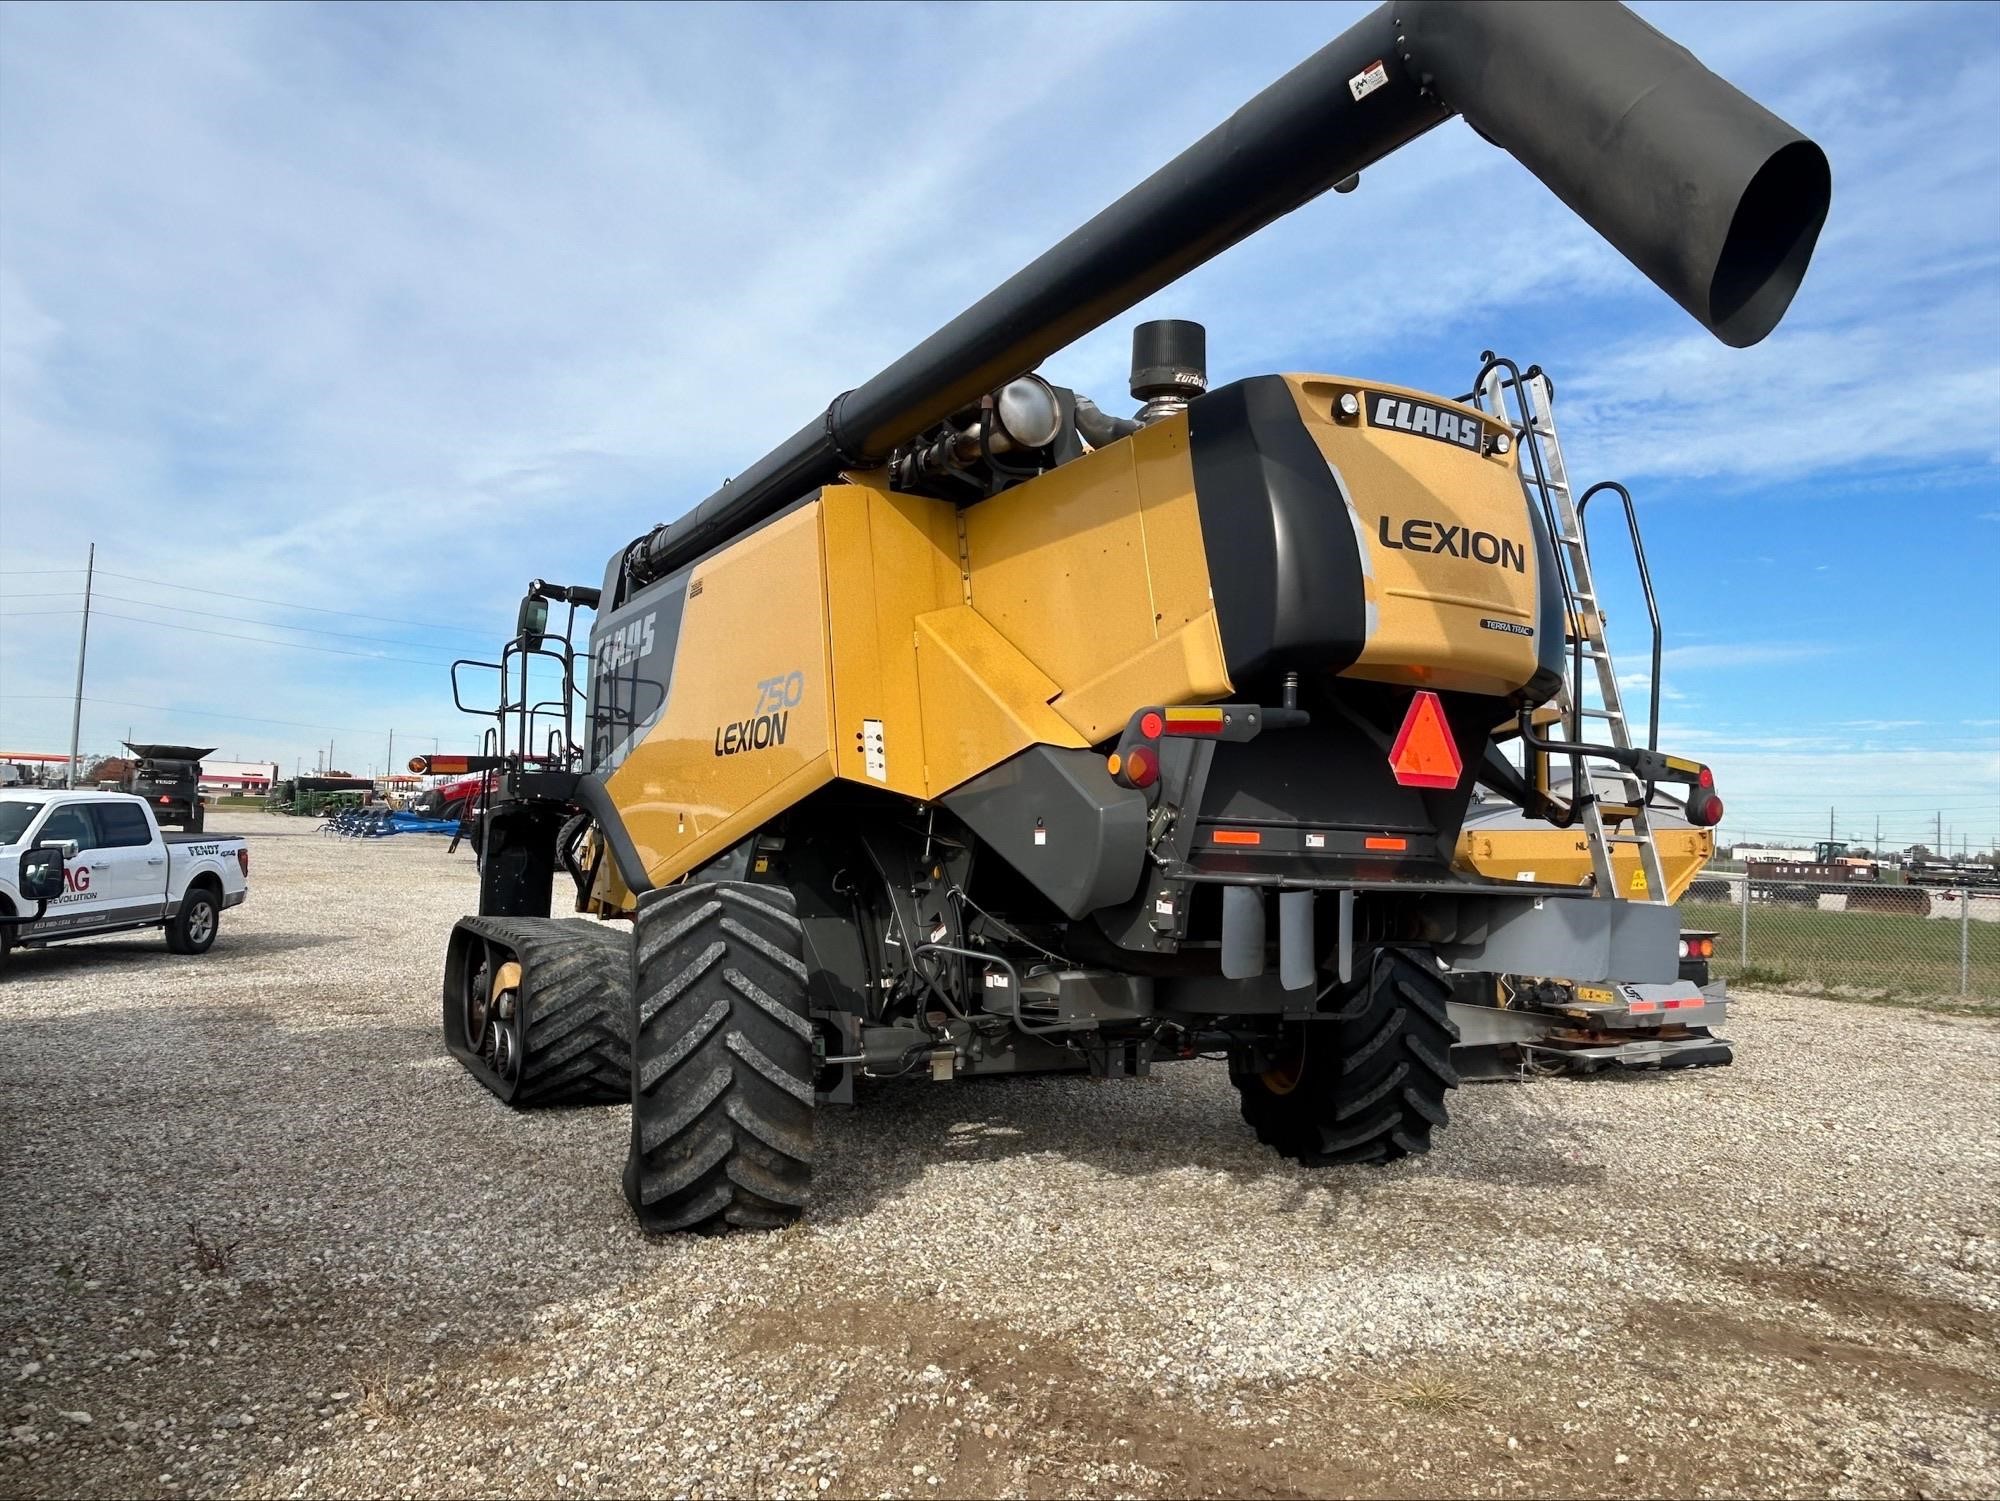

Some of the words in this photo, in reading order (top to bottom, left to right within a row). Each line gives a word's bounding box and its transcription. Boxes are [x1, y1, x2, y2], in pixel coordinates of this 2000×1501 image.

[1175, 373, 1204, 387] turbo
[1375, 398, 1477, 447] CLAAS
[1379, 515, 1526, 574] LEXION
[1486, 620, 1512, 632] TERRA
[1511, 624, 1530, 635] TRAC
[754, 671, 804, 715] 750
[714, 710, 789, 757] LEXION
[187, 844, 220, 857] FENDT
